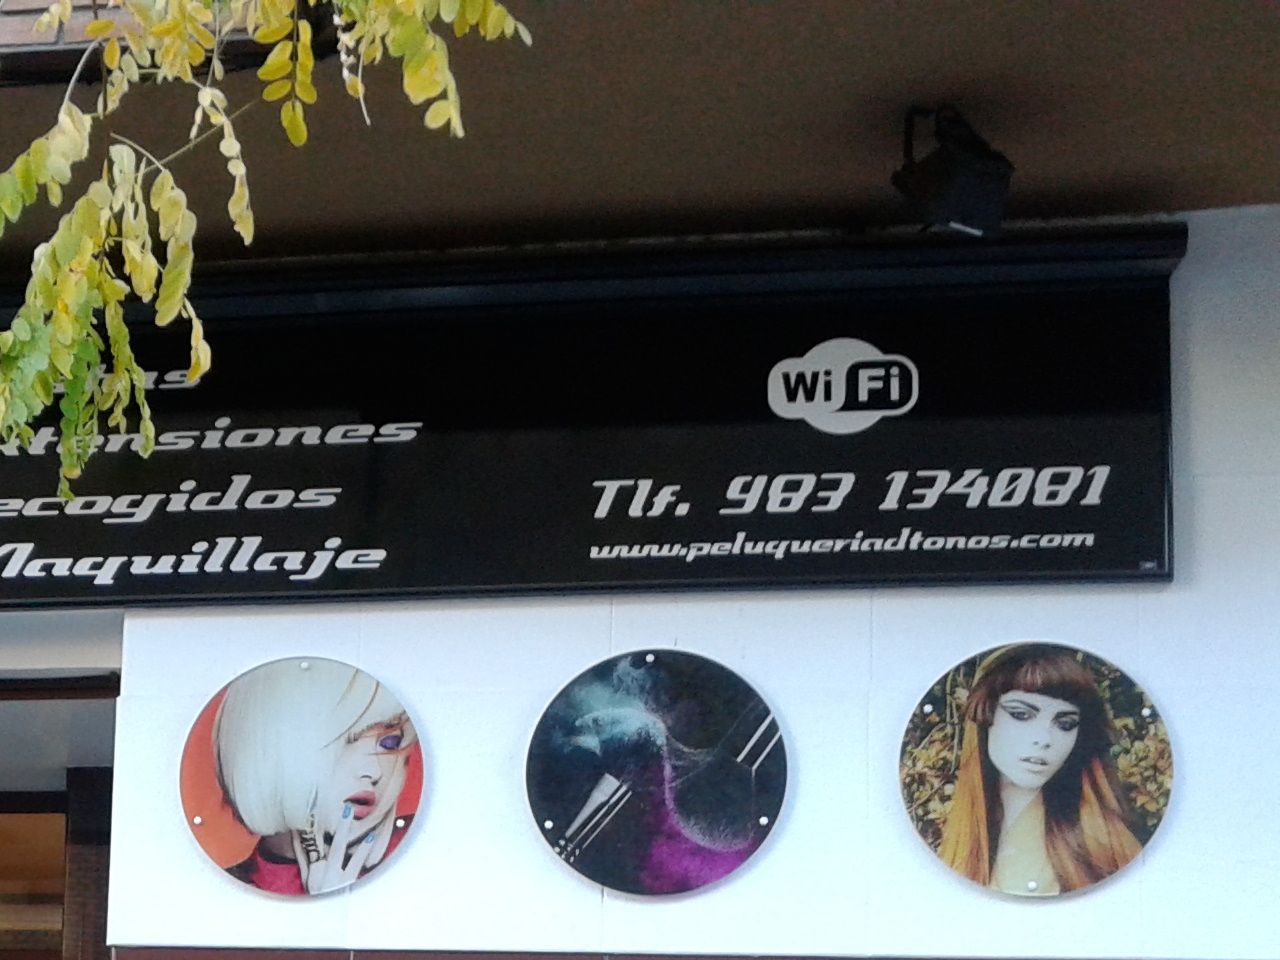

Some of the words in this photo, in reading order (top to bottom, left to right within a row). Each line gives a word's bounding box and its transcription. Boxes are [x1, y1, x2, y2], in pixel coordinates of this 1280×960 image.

[592, 478, 691, 519] Tlf.
[719, 472, 856, 514] 983
[878, 464, 1112, 512] 134081
[589, 526, 1096, 563] www.peluqueriadtonos.com
